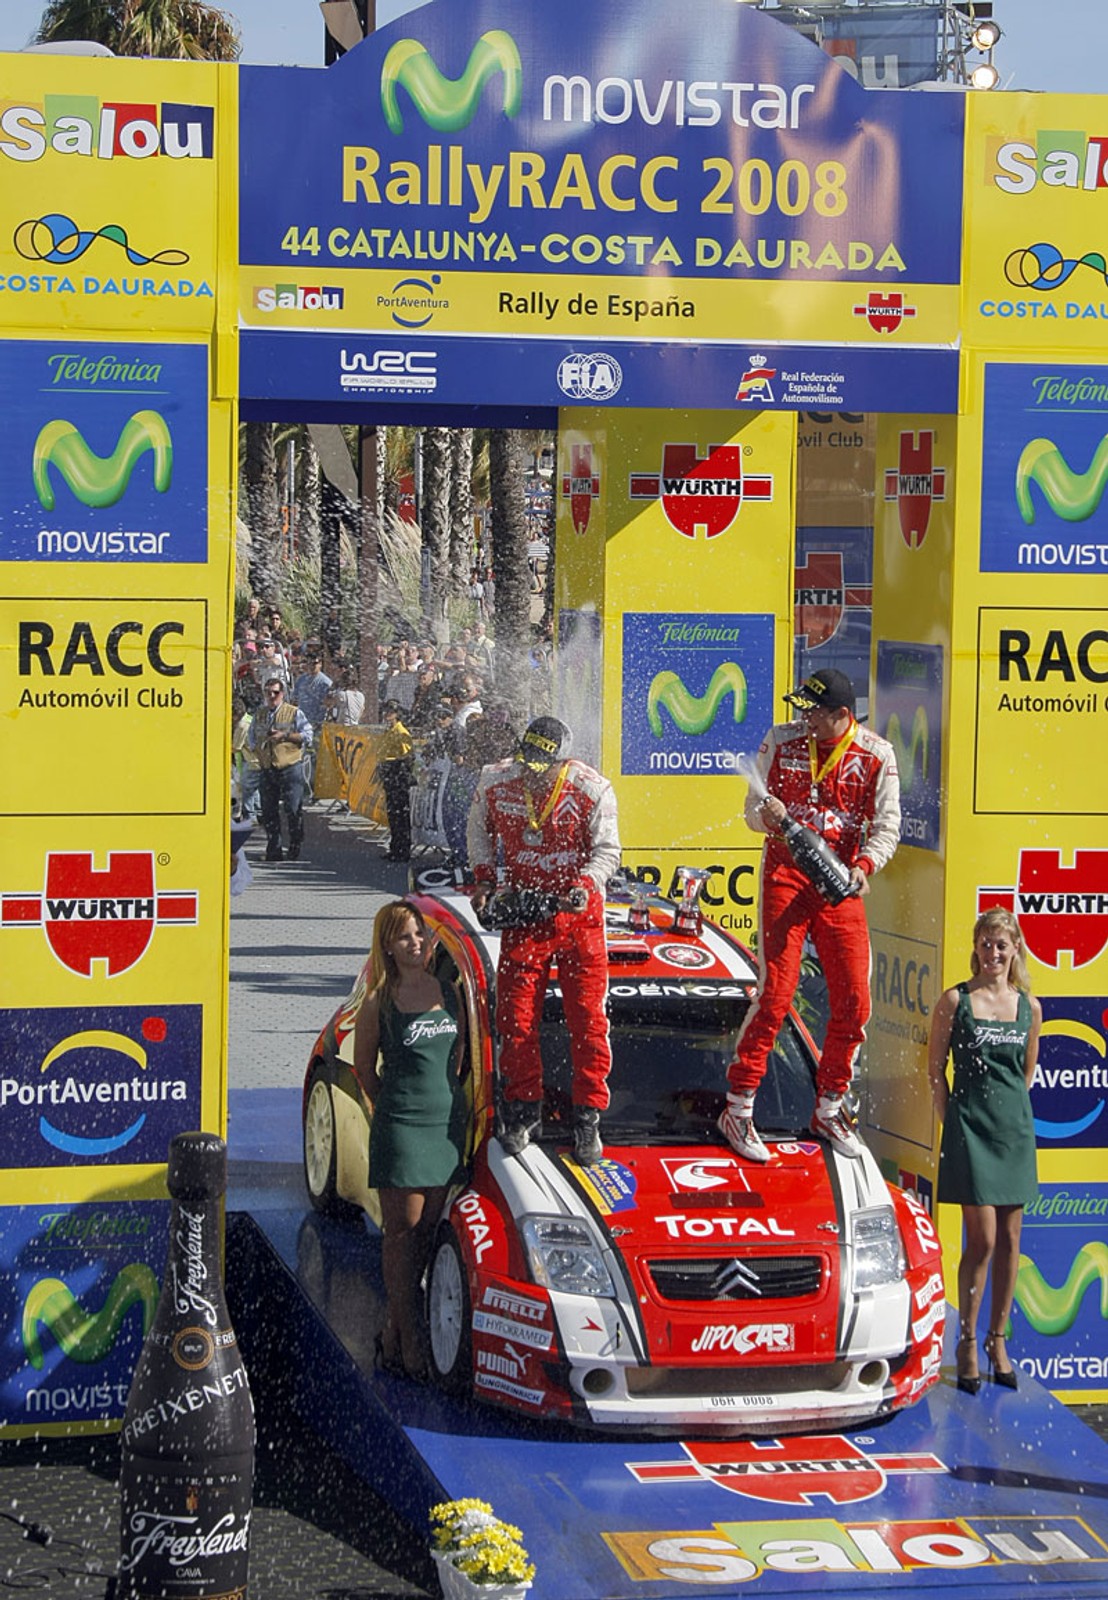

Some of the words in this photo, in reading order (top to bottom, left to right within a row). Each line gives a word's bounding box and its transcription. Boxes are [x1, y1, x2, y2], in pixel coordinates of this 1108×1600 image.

[543, 74, 815, 130] movistar
[0, 106, 204, 162] Salou
[993, 142, 1108, 195] Sal
[342, 145, 679, 223] RallyRACC
[700, 158, 848, 217] 2008
[281, 227, 321, 256] 44
[695, 237, 907, 272] DAURADA
[84, 277, 214, 298] DAURADA
[257, 290, 341, 312] Salou
[377, 296, 450, 309] PortAventura
[499, 292, 558, 319] Rally
[567, 294, 598, 316] de
[607, 296, 695, 322] España
[979, 300, 1058, 318] COSTA
[48, 353, 163, 384] Telefónica
[340, 349, 437, 373] WRC
[781, 372, 799, 382] Real
[800, 372, 845, 383] Federación
[788, 383, 826, 394] Española
[827, 384, 838, 393] de
[781, 393, 844, 404] Automovilismo
[827, 432, 864, 448] Club
[37, 530, 170, 554] movistar
[658, 622, 740, 644] Telefónica
[18, 621, 185, 677] RACC
[19, 687, 129, 708] Automóvil
[137, 688, 183, 708] Club
[998, 693, 1097, 713] Automóvil
[650, 752, 746, 769] movistar
[720, 914, 753, 929] Club
[876, 951, 930, 1017] RACC
[0, 1078, 187, 1105] PortAventura
[456, 1190, 494, 1264] TOTAL
[655, 1214, 795, 1238] TOTAL
[174, 1206, 218, 1326] Freixenet
[483, 1286, 547, 1322] PIRELLI
[478, 1350, 518, 1379] PUMA
[124, 1368, 243, 1446] FREIXENET
[121, 1510, 251, 1571] Freixenet
[176, 1567, 202, 1578] CAVA
